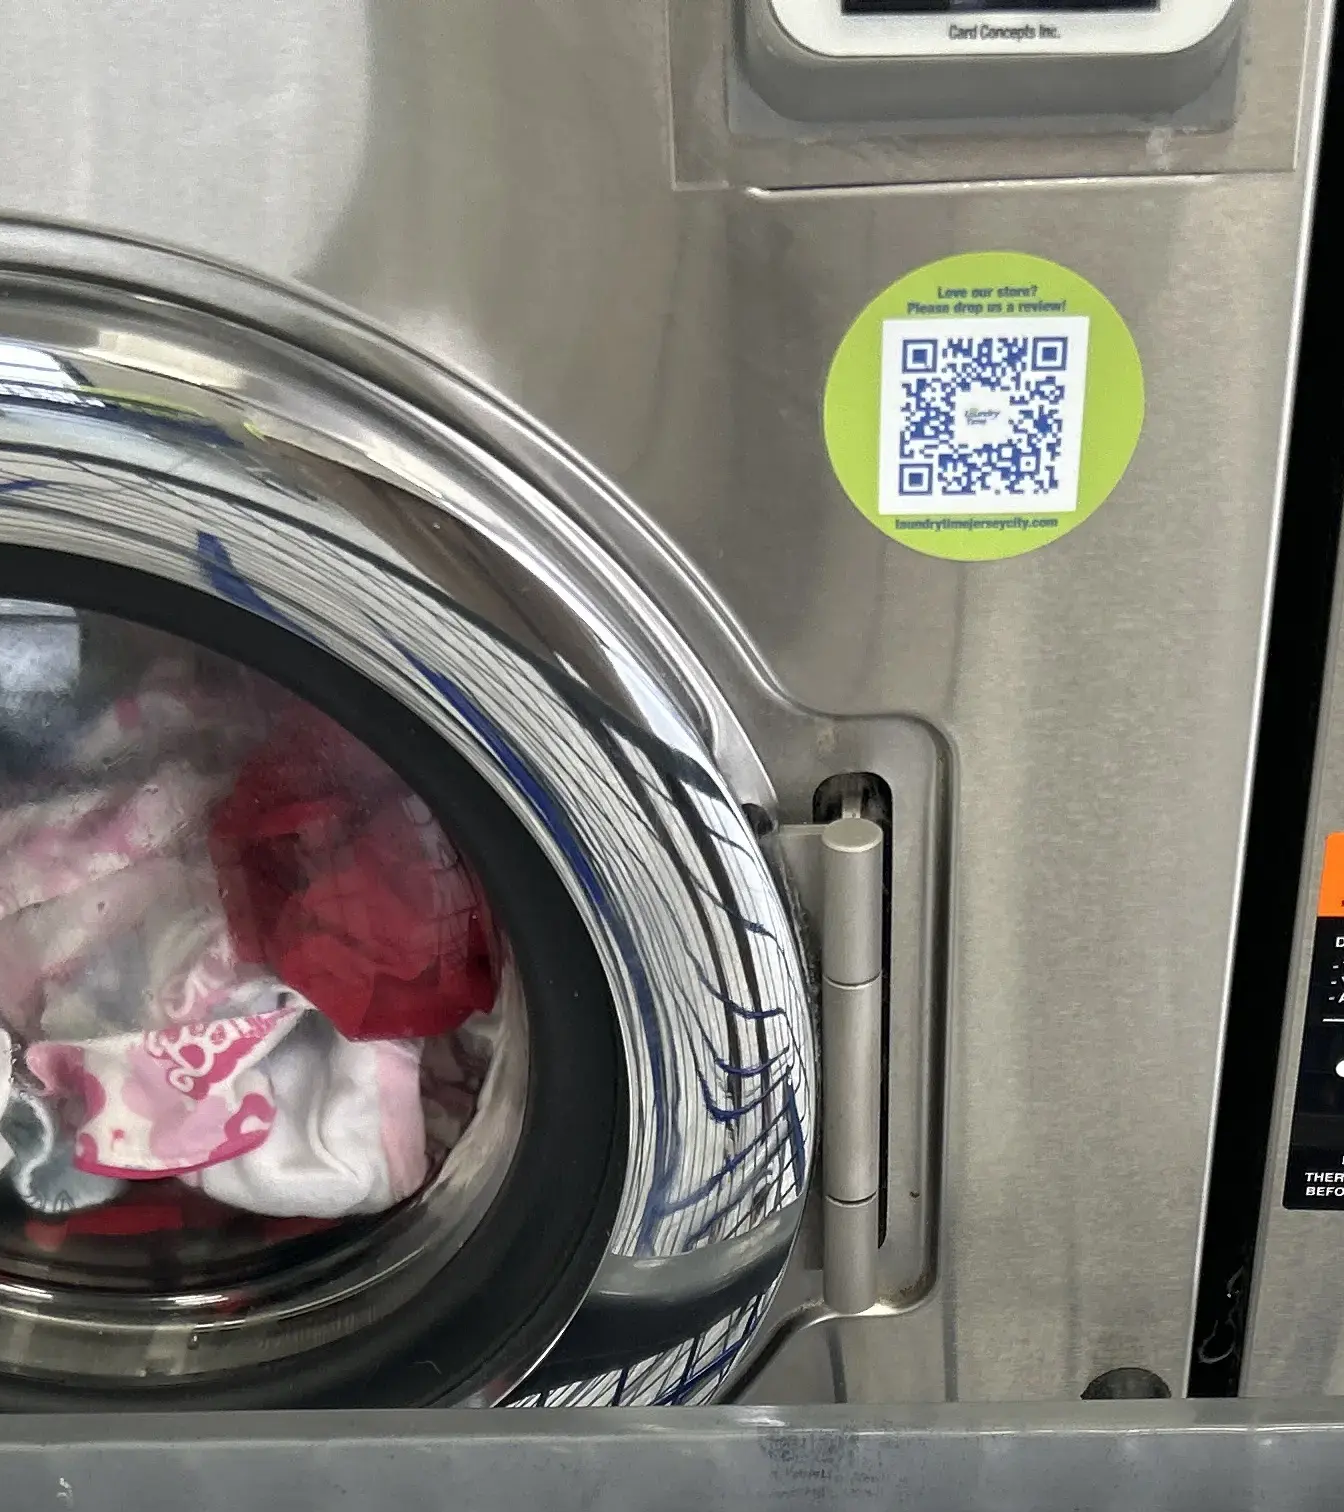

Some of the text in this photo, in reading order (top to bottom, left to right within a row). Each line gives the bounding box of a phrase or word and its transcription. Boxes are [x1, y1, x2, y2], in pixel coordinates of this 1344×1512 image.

[949, 24, 977, 39] Card
[980, 24, 1036, 42] Concepts
[938, 285, 1037, 299] Love our store?
[907, 300, 1067, 315] Please drop us a review!
[895, 517, 1058, 531] laundrytimejerseycity.com
